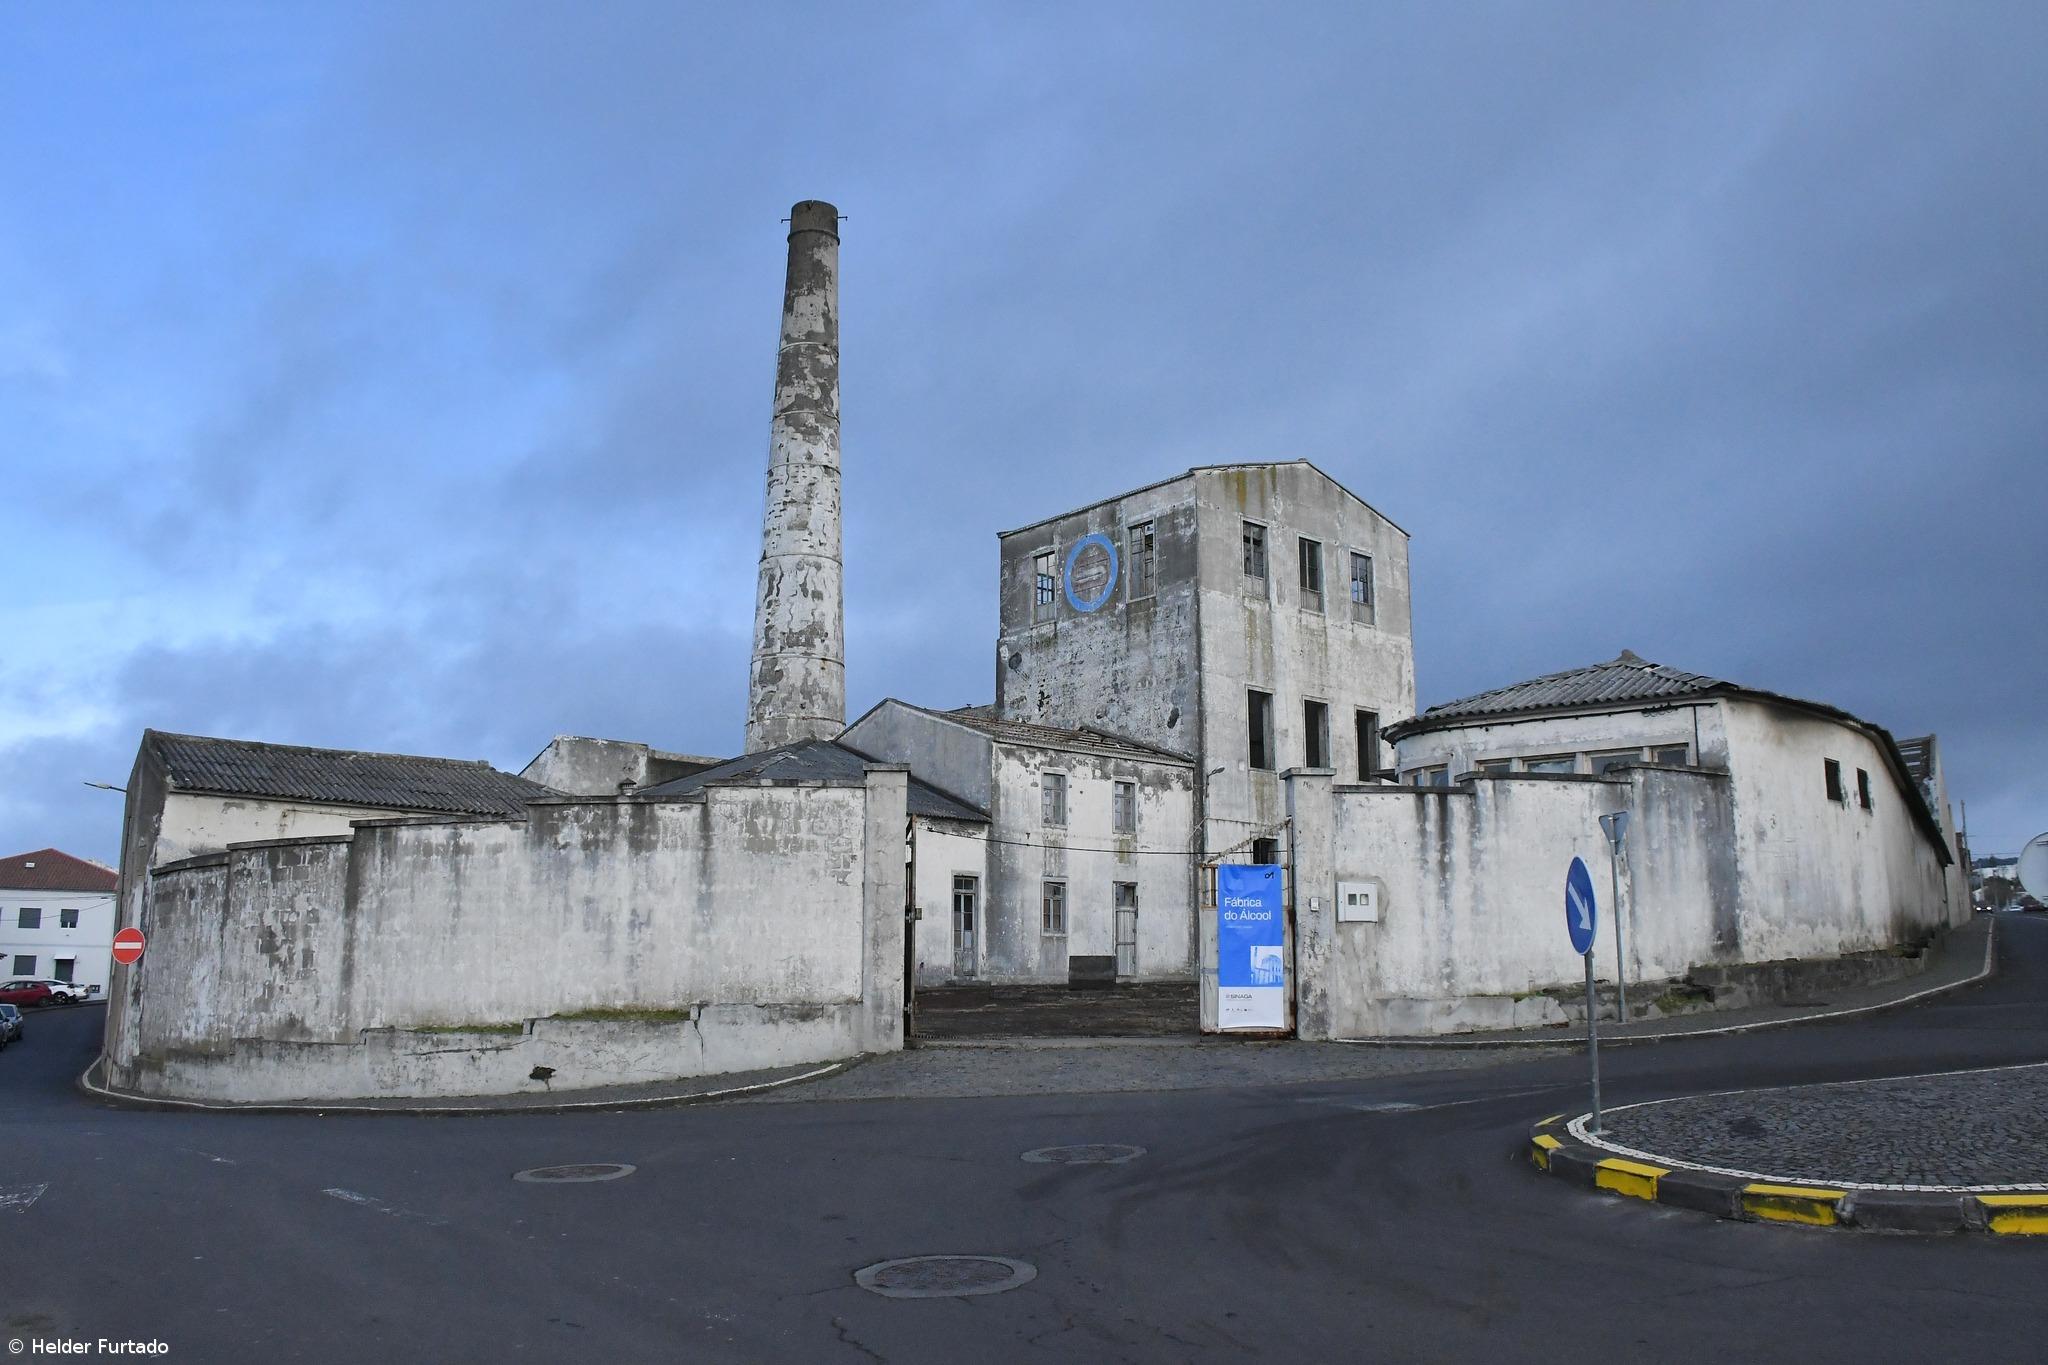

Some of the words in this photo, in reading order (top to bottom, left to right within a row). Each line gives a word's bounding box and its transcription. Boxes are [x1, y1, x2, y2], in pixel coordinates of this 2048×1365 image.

[1224, 896, 1263, 908] Fábrica
[1224, 910, 1238, 921] do
[1239, 908, 1272, 921] Álcool
